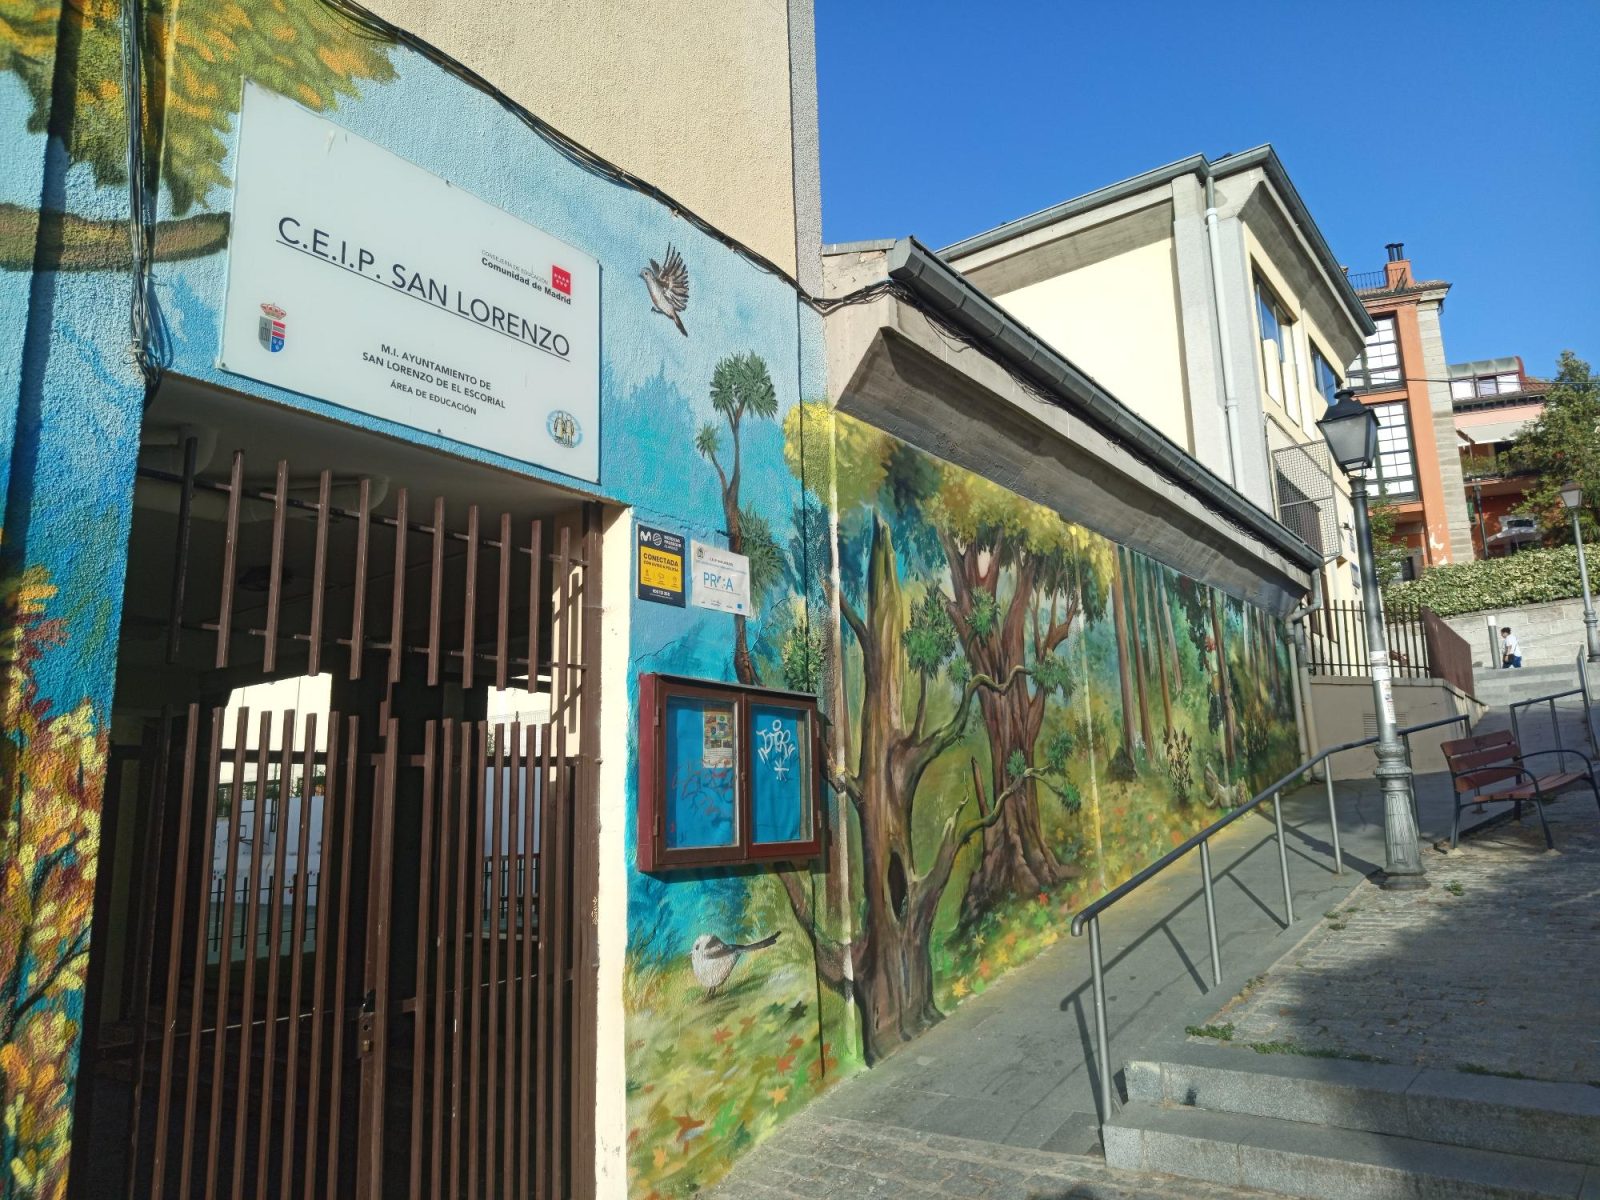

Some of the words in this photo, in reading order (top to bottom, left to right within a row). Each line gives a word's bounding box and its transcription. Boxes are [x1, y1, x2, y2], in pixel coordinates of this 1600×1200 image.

[278, 216, 381, 280] C.E.I.P.
[391, 263, 448, 307] SAN
[457, 290, 571, 357] LORENZO
[481, 257, 530, 286] Comunidad
[532, 281, 543, 292] de
[544, 286, 572, 305] Madrid
[362, 352, 384, 367] SAN
[386, 360, 434, 384] LORENZO
[436, 377, 449, 389] DE
[451, 383, 462, 394] EL
[464, 387, 506, 409] ESCORIAL
[381, 343, 399, 358] M.I.
[401, 352, 477, 385] AYUNTAMIENTO
[479, 379, 492, 391] DE
[390, 379, 414, 395] ÁREA
[415, 388, 428, 399] DE
[429, 393, 477, 415] EDUCACIÓN
[643, 552, 679, 567] CONECTADA
